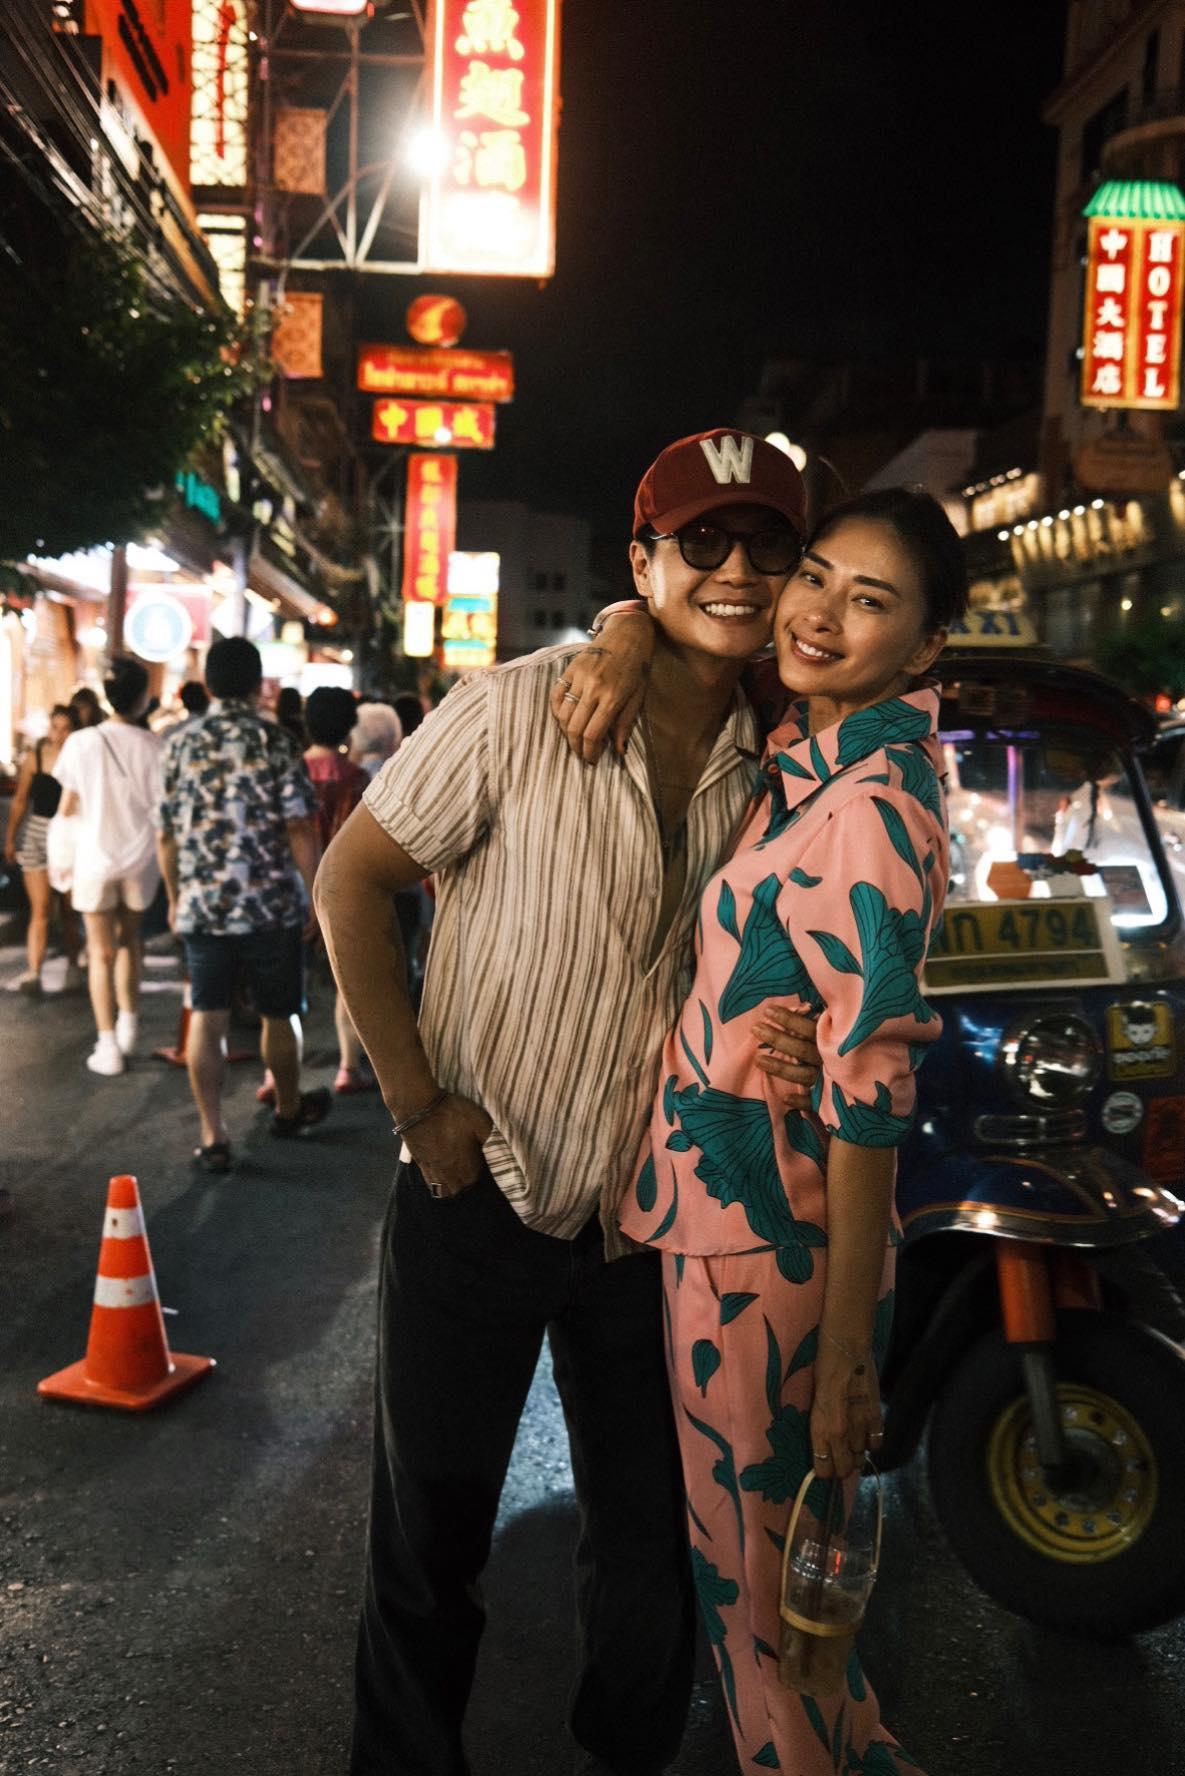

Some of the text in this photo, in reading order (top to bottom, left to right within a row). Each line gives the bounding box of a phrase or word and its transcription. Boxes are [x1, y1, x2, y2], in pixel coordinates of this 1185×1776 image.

[1143, 231, 1175, 398] HOTEL
[699, 435, 754, 484] W
[998, 905, 1099, 949] 4794
